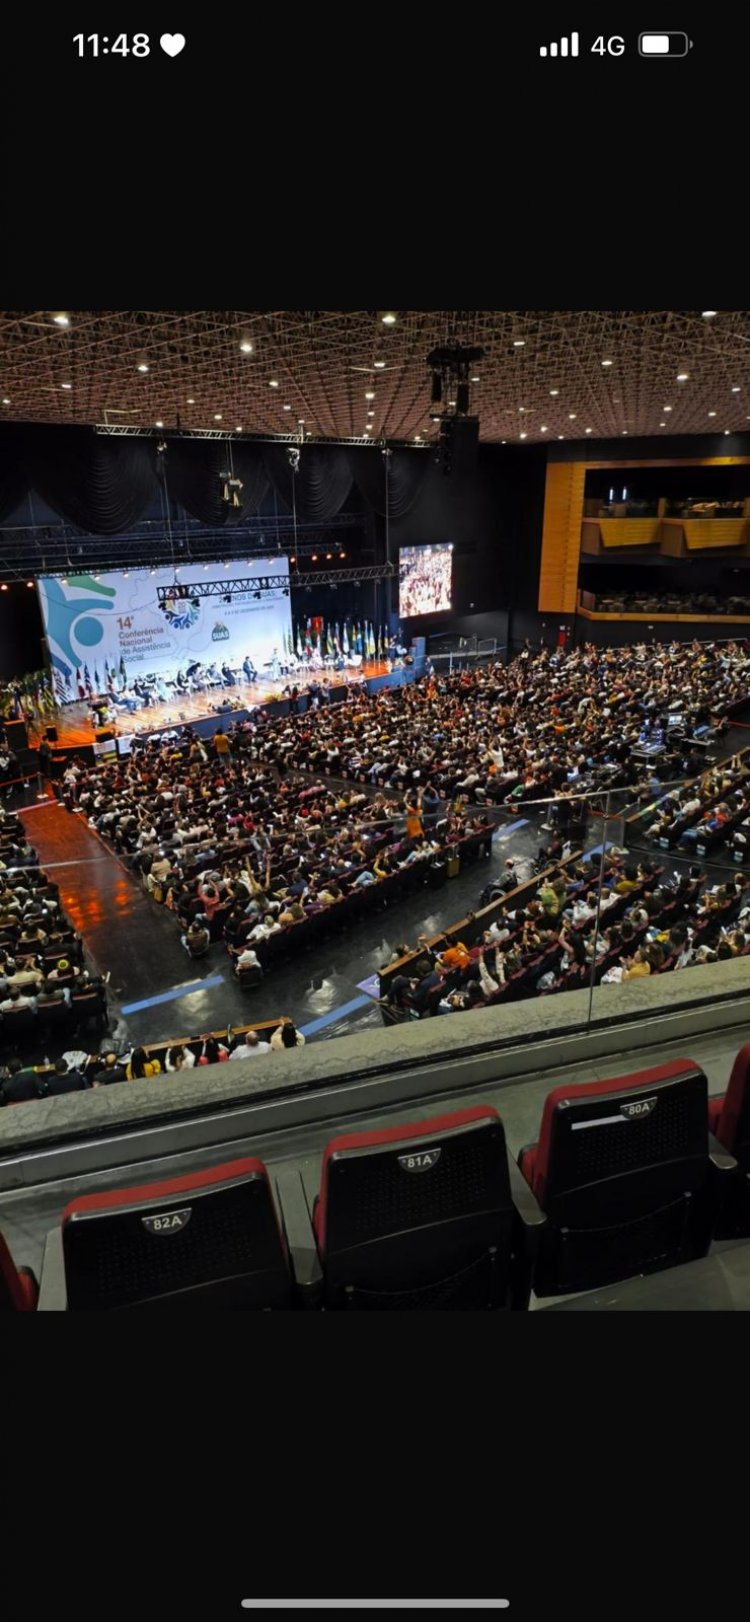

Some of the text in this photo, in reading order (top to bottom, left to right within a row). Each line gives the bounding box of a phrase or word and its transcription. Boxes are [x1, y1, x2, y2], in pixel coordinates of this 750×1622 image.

[119, 627, 164, 639] Conferência
[212, 631, 228, 639] SUAS
[119, 636, 153, 647] Nacional
[132, 641, 171, 653] Assistência
[628, 1103, 650, 1115] 80A
[407, 1154, 432, 1168] 81A
[153, 1215, 182, 1230] 82A
